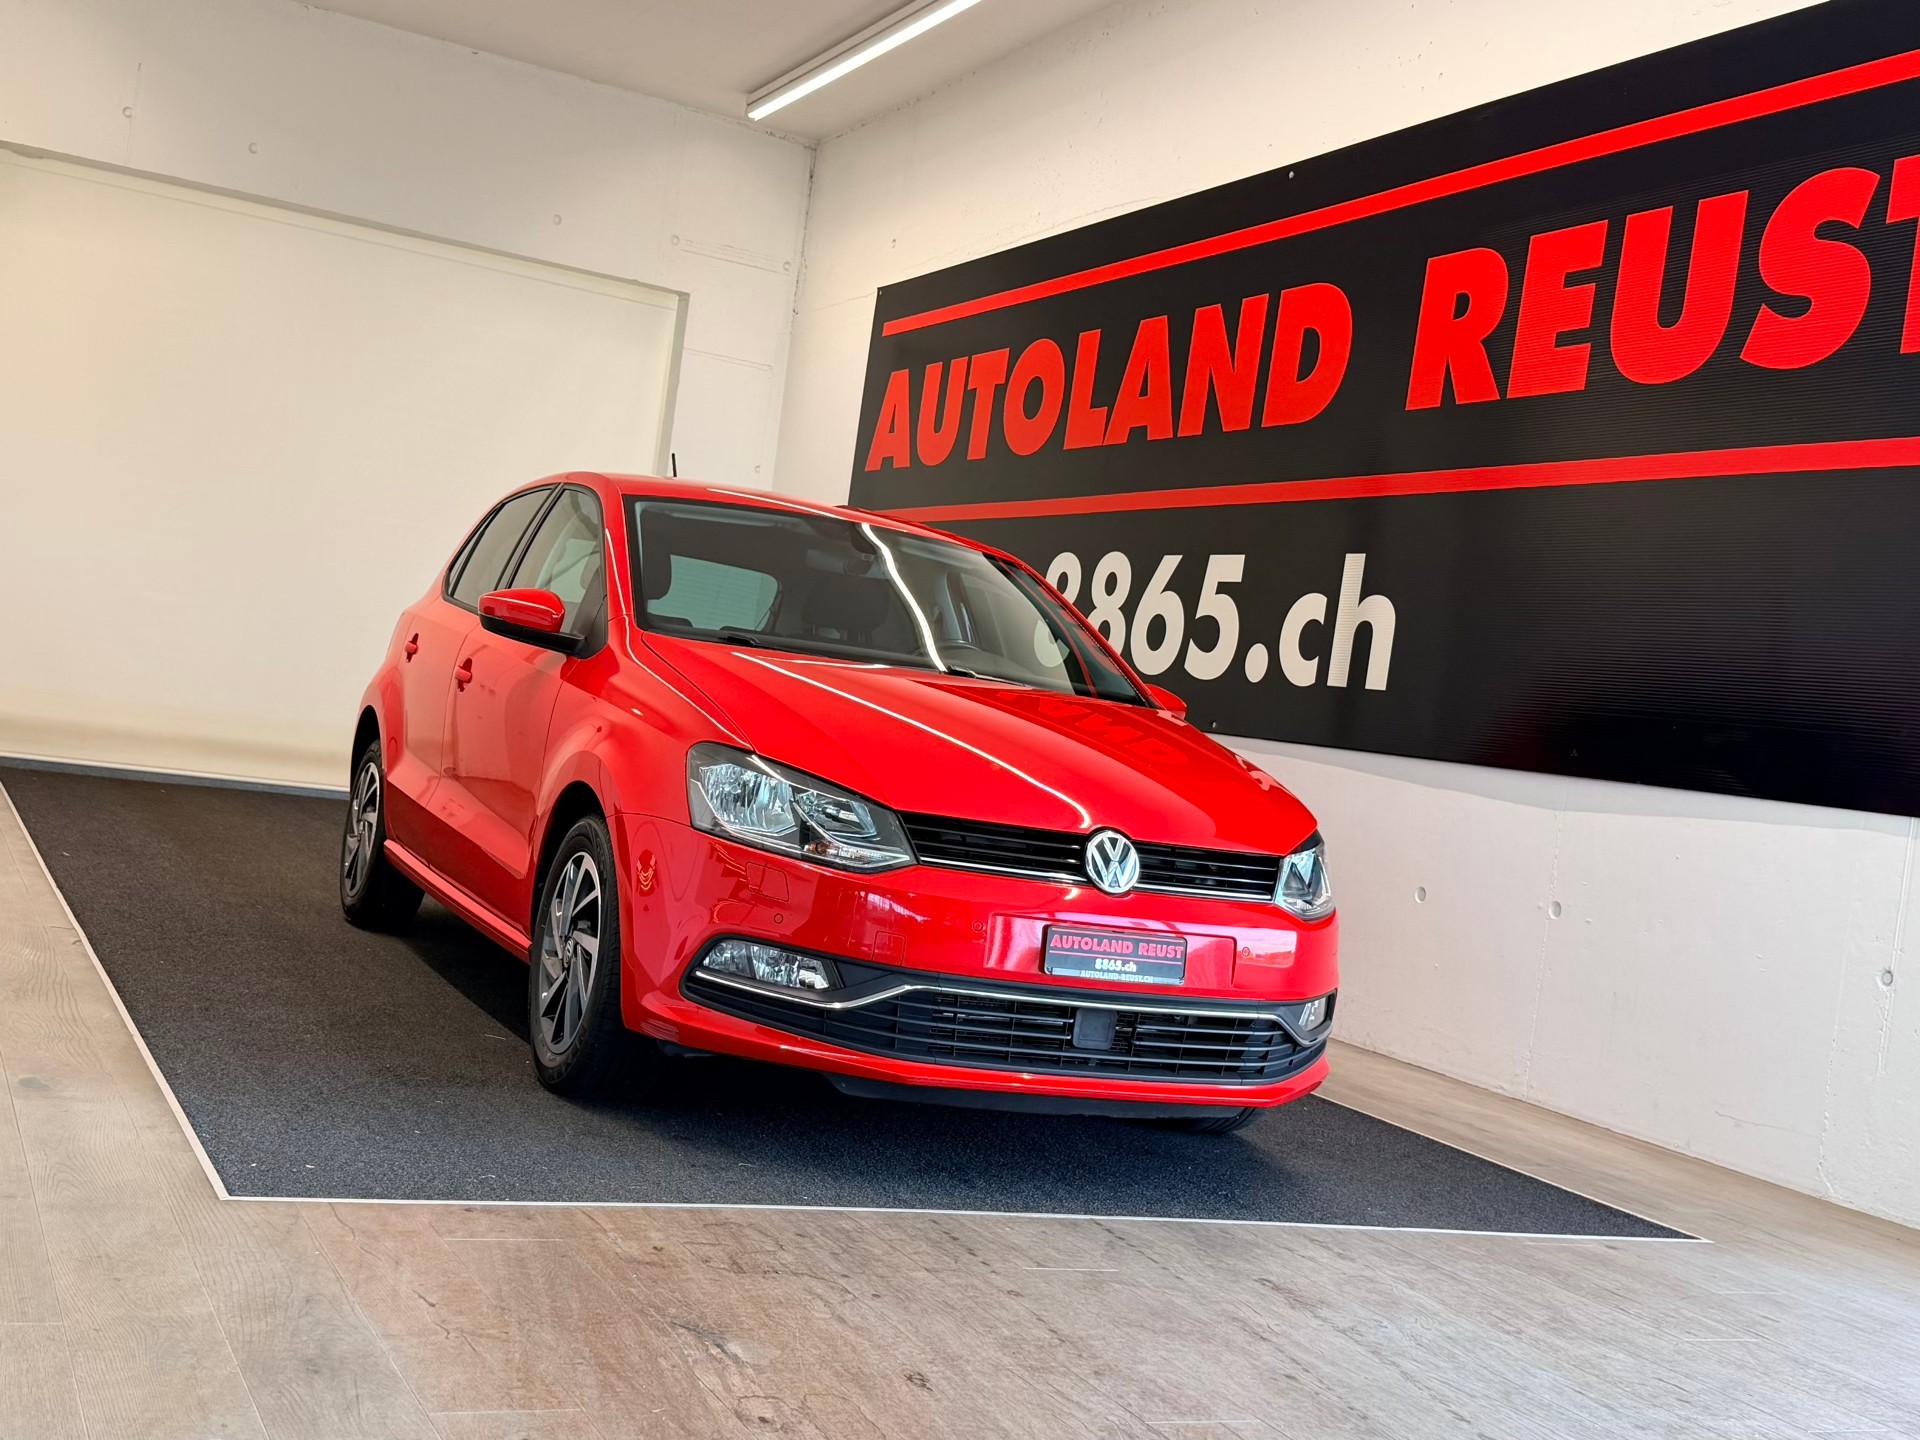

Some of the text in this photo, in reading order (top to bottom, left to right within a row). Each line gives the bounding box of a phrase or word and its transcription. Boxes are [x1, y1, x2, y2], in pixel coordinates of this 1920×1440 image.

[864, 282, 1353, 472] AUTOLAND
[1050, 934, 1184, 959] AUTOLAND REUST
[1094, 958, 1137, 973] 8865.ch
